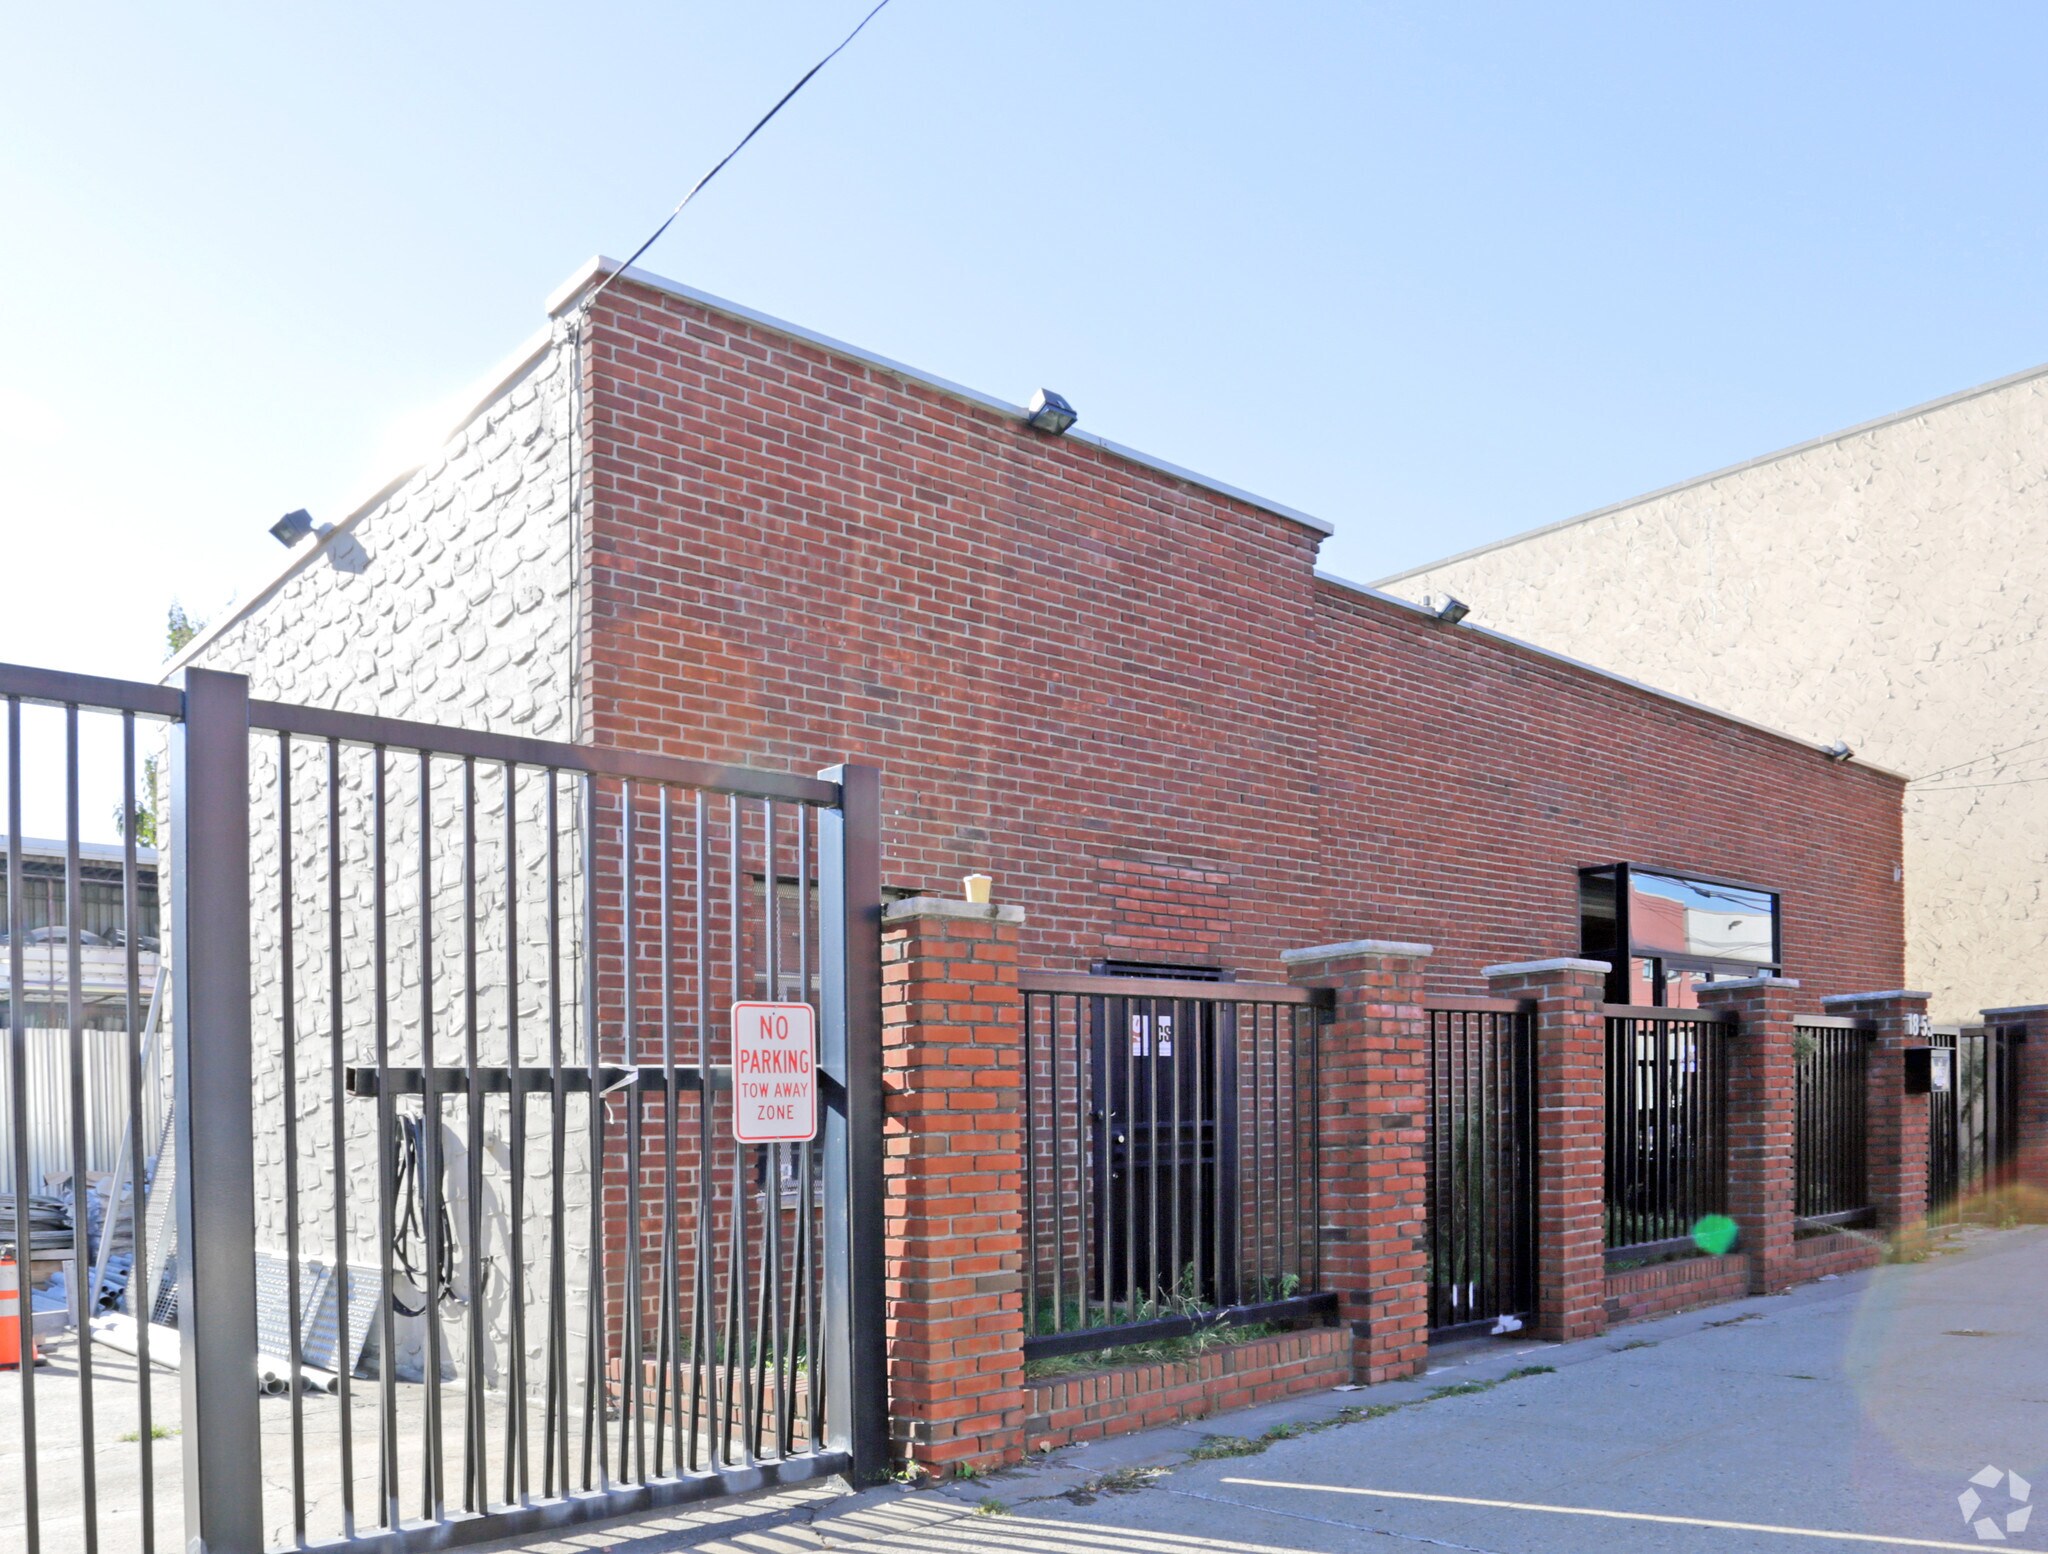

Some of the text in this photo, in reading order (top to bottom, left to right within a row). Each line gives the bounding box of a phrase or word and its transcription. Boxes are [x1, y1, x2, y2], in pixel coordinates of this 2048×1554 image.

[760, 1015, 789, 1040] NO
[740, 1049, 809, 1074] PARKING
[742, 1082, 809, 1098] TOW AWAY
[757, 1104, 794, 1120] ZONE
